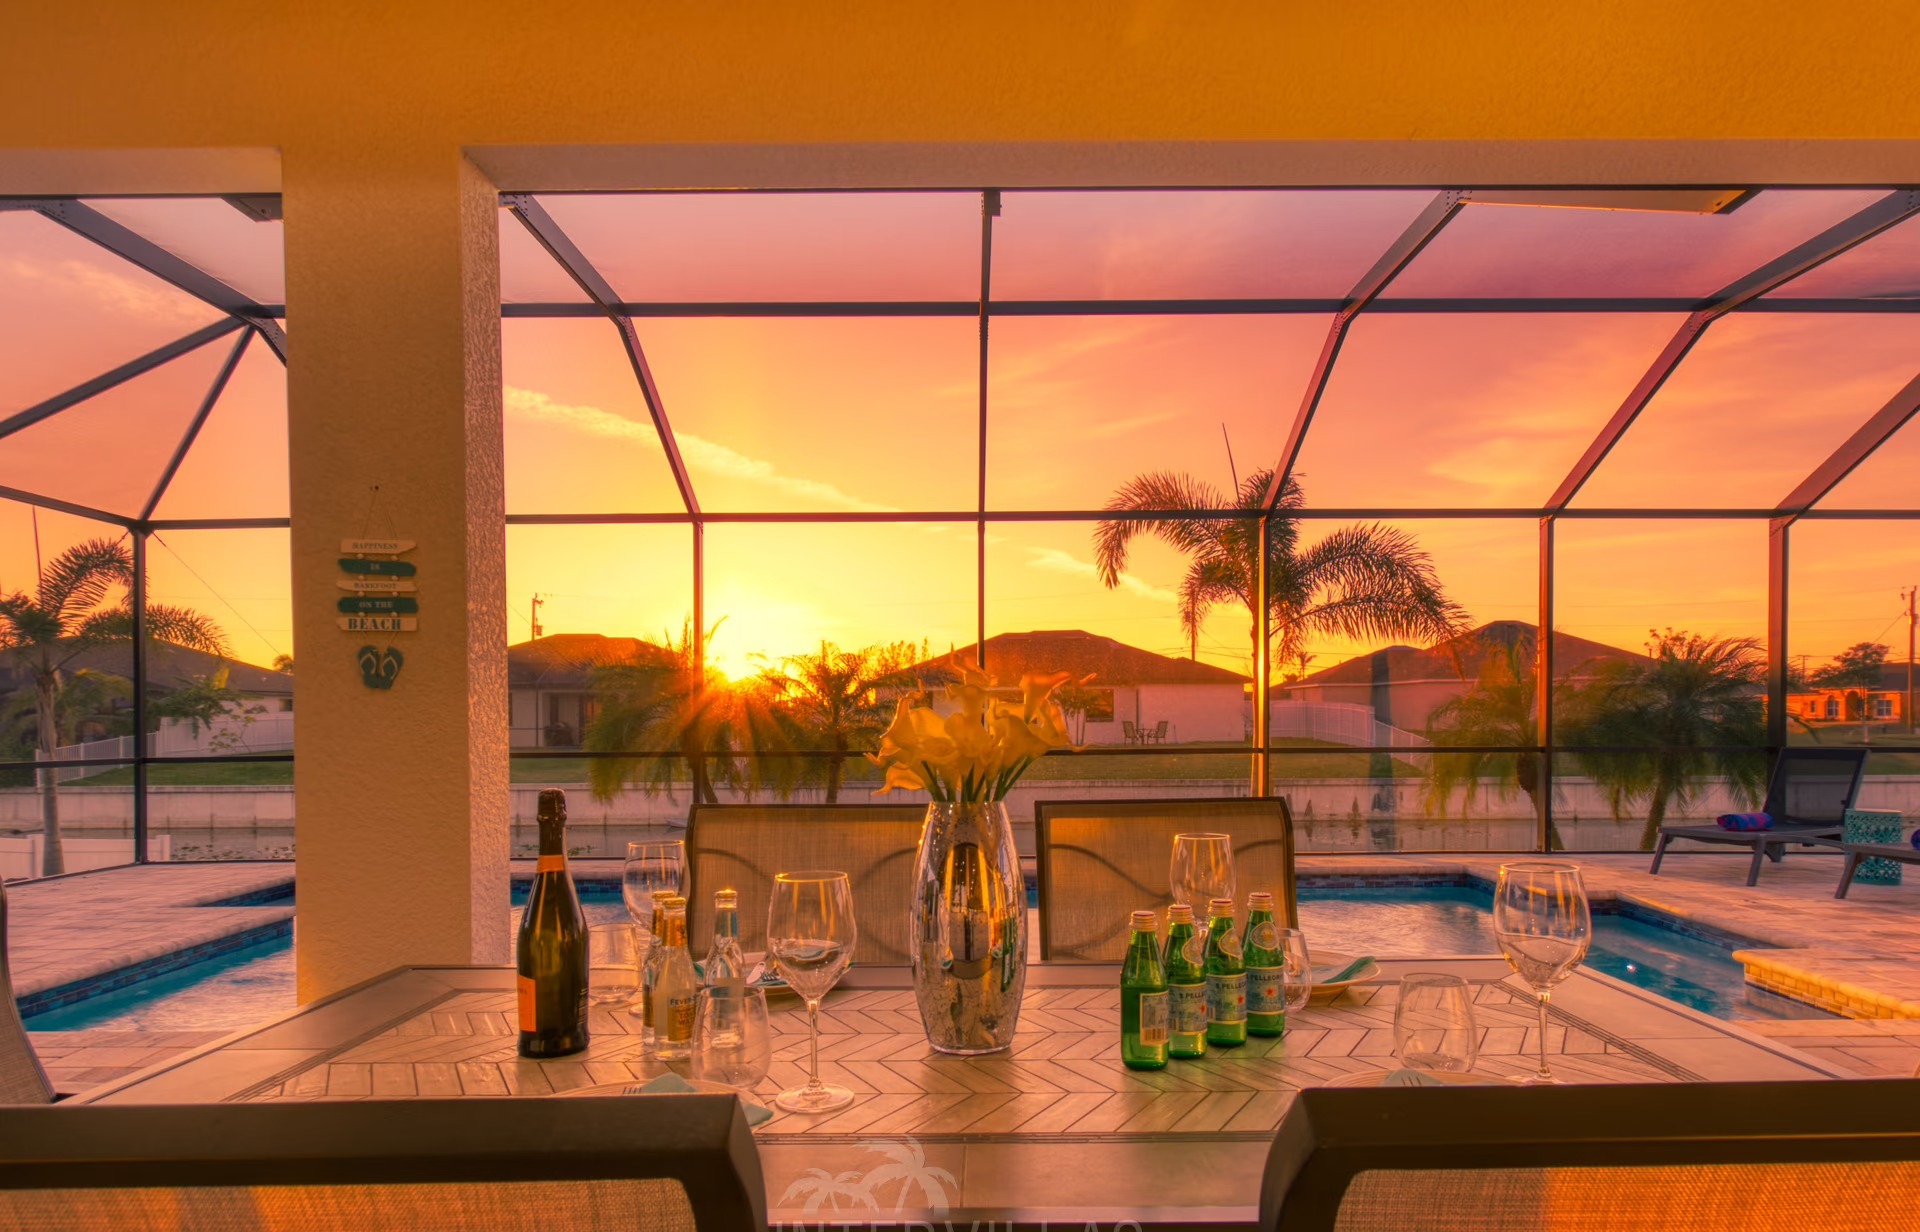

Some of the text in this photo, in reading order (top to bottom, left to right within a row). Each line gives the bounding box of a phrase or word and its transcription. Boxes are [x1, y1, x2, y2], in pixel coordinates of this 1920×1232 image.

[352, 542, 398, 550] HAPPINESS
[370, 563, 380, 571] IS
[359, 601, 393, 609] ON THE
[348, 618, 401, 630] BEACH
